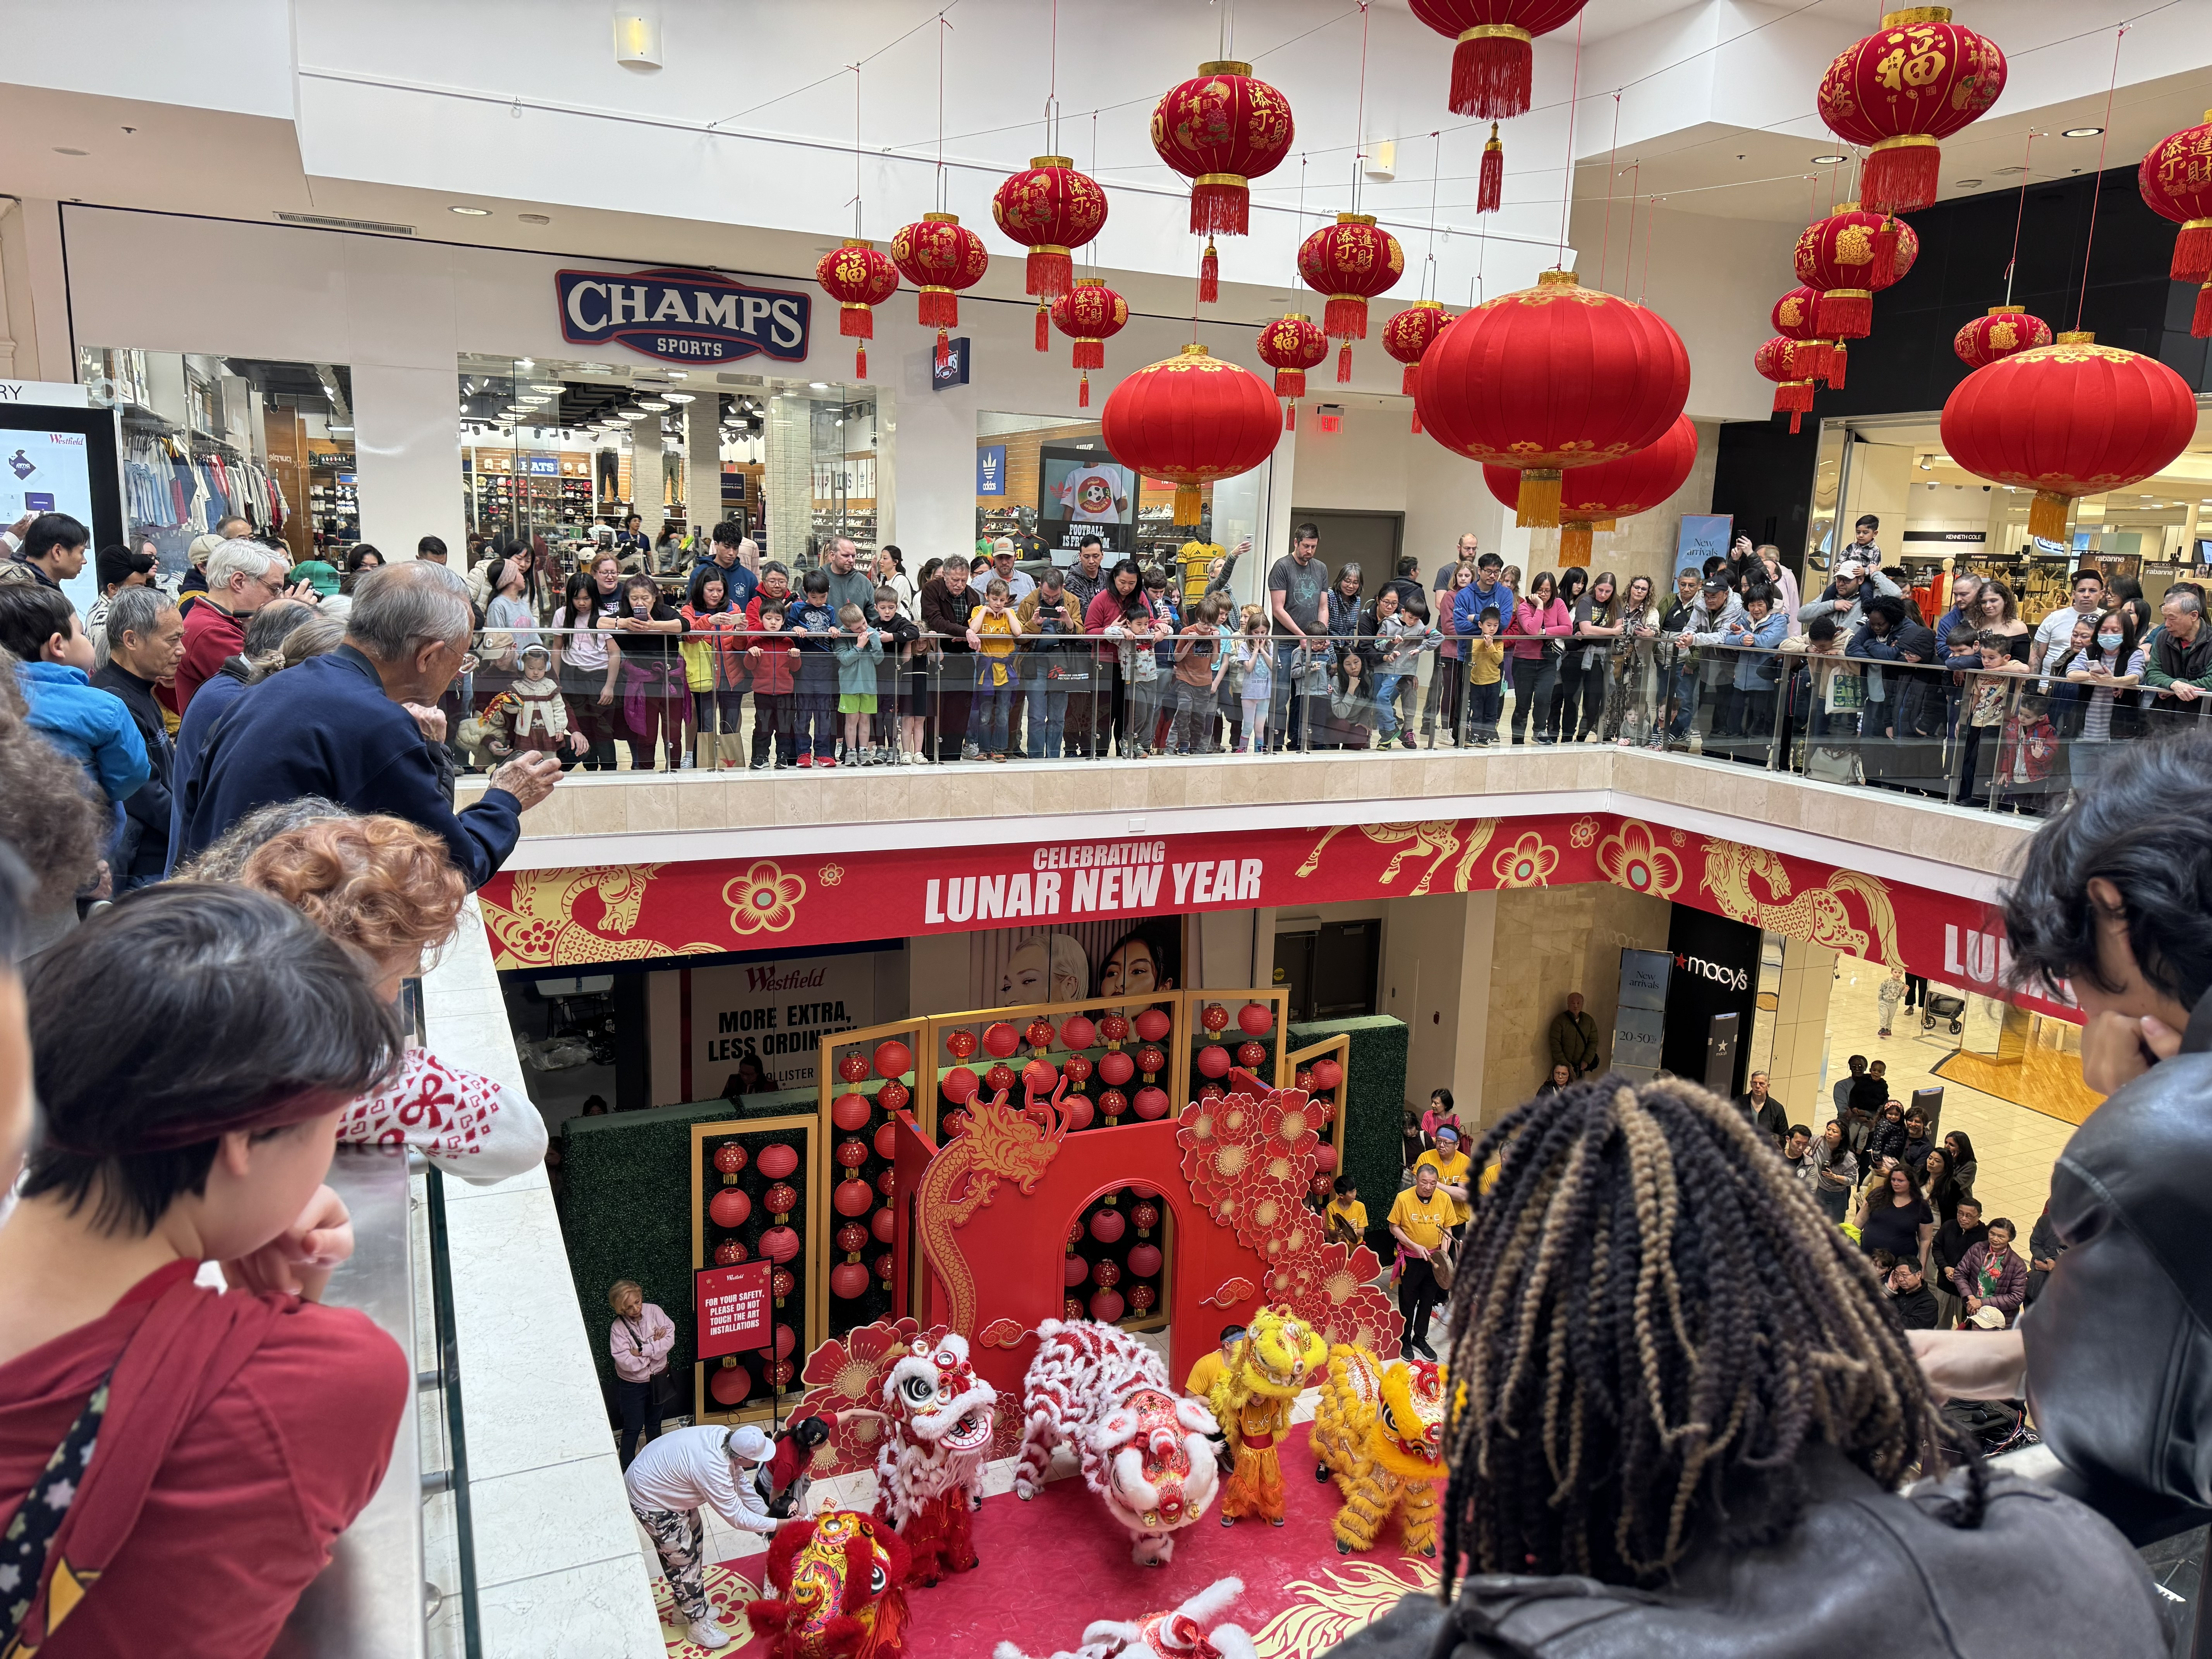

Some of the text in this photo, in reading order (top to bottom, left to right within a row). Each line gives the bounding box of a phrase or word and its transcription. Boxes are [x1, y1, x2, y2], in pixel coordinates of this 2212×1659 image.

[1877, 28, 1946, 91] 福
[836, 254, 866, 283] 福
[567, 281, 802, 348] CHAMPS
[1273, 325, 1299, 350] 福
[658, 338, 723, 357] SPORTS
[1322, 416, 1340, 432] EXIT
[50, 434, 84, 445] Westfield
[837, 473, 852, 489] KS
[983, 481, 996, 491] adidas
[1069, 524, 1104, 537] FOOTBALL
[1062, 536, 1069, 547] IS
[1694, 538, 1714, 547] New
[1687, 548, 1718, 556] arrivals
[1033, 841, 1165, 871] CELEBRATING
[925, 859, 1263, 924] LUNAR NEW YEAR
[744, 965, 828, 993] Westfield
[1636, 970, 1656, 980] New
[1629, 979, 1659, 989] arrivals
[718, 1001, 851, 1034] MORE EXTRA,
[708, 1036, 756, 1062] LESS
[765, 1067, 814, 1082] OLLISTER
[705, 1289, 765, 1307] FOR YOUR SAFETY,
[710, 1300, 760, 1316] PLEASE DO NOT
[710, 1309, 760, 1326] TOUCH THE ART
[710, 1319, 760, 1336] INSTALLATIONS
